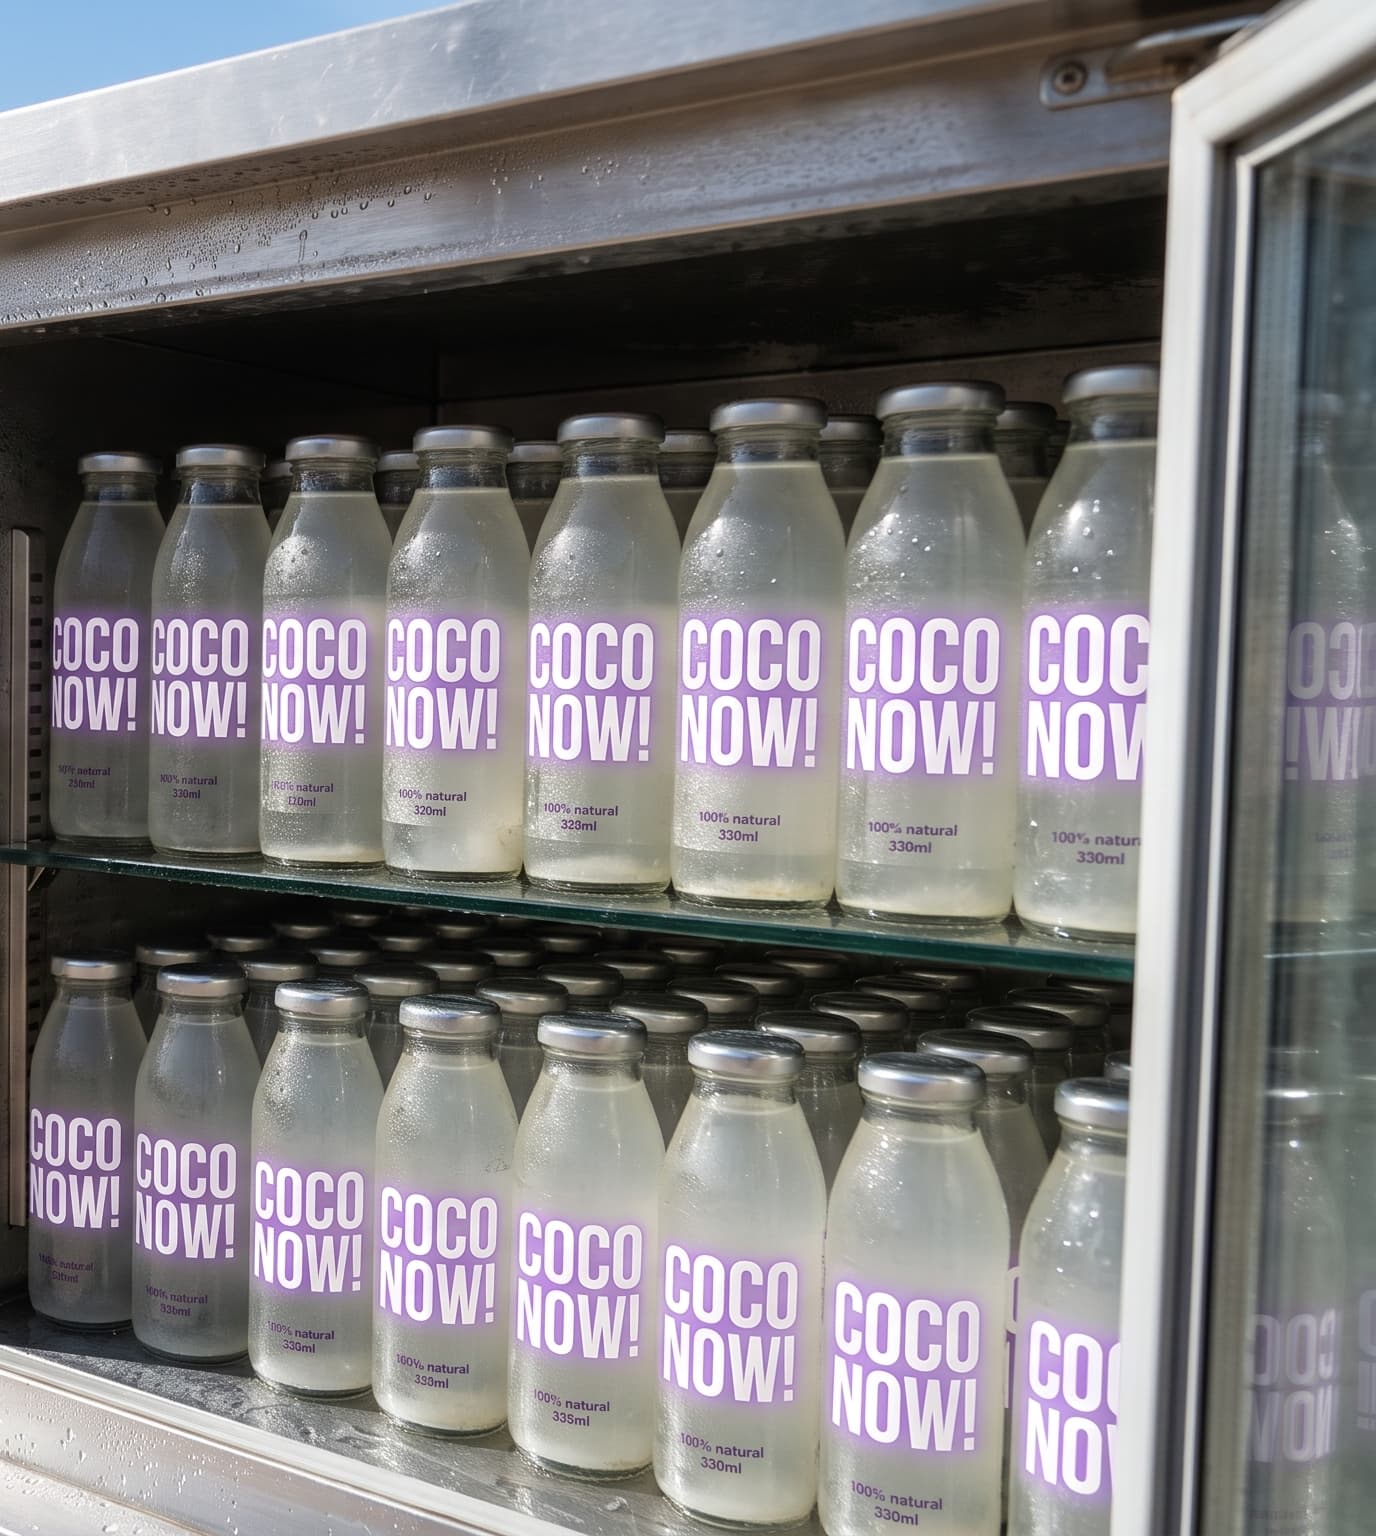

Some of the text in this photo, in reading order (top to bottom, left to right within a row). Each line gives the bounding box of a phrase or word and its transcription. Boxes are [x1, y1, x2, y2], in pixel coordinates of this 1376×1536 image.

[53, 617, 139, 673] COCO
[152, 618, 249, 677] COCO
[263, 618, 366, 680] COCO
[387, 618, 501, 683] COCO
[530, 622, 654, 691] COCO
[682, 618, 821, 692] COCO
[848, 617, 1000, 695] COCO
[52, 676, 137, 731] NOW!
[151, 680, 247, 738] NOW!
[262, 684, 365, 744] NOW!
[386, 686, 497, 750] NOW!
[528, 693, 651, 762] NOW!
[680, 694, 818, 768] NOW!
[847, 697, 996, 775] NOW!
[173, 789, 201, 799] 330ml
[182, 776, 218, 785] natural
[296, 783, 334, 793] natural
[399, 789, 467, 802] 100% natural
[544, 803, 618, 816] 100% natural
[414, 805, 446, 816] 320ml
[718, 829, 758, 842] 330ml
[733, 815, 781, 826] natural
[868, 822, 958, 836] 100% natural
[1052, 832, 1090, 844] 100%
[888, 840, 932, 853] 330ml
[1077, 851, 1125, 865] 330ml
[30, 1108, 121, 1171] COCO
[136, 1133, 236, 1199] COCO
[29, 1162, 120, 1229] NOW!
[135, 1190, 235, 1259] NOW!
[255, 1161, 363, 1230] COCO
[381, 1186, 497, 1259] COCO
[254, 1221, 362, 1293] NOW!
[519, 1212, 642, 1290] COCO
[170, 1294, 208, 1304] natural
[379, 1249, 495, 1325] NOW!
[664, 1244, 798, 1329] COCO
[295, 1330, 335, 1340] natural
[517, 1277, 639, 1359] NOW!
[835, 1281, 980, 1373] COCO
[427, 1364, 469, 1374] natural
[663, 1313, 795, 1403] NOW!
[534, 1389, 610, 1412] 100% natural
[832, 1354, 976, 1452] NOW!
[681, 1432, 764, 1458] 100% natural
[701, 1456, 742, 1474] 330ml
[851, 1480, 943, 1510] 100% natural
[874, 1506, 919, 1526] 330ml
